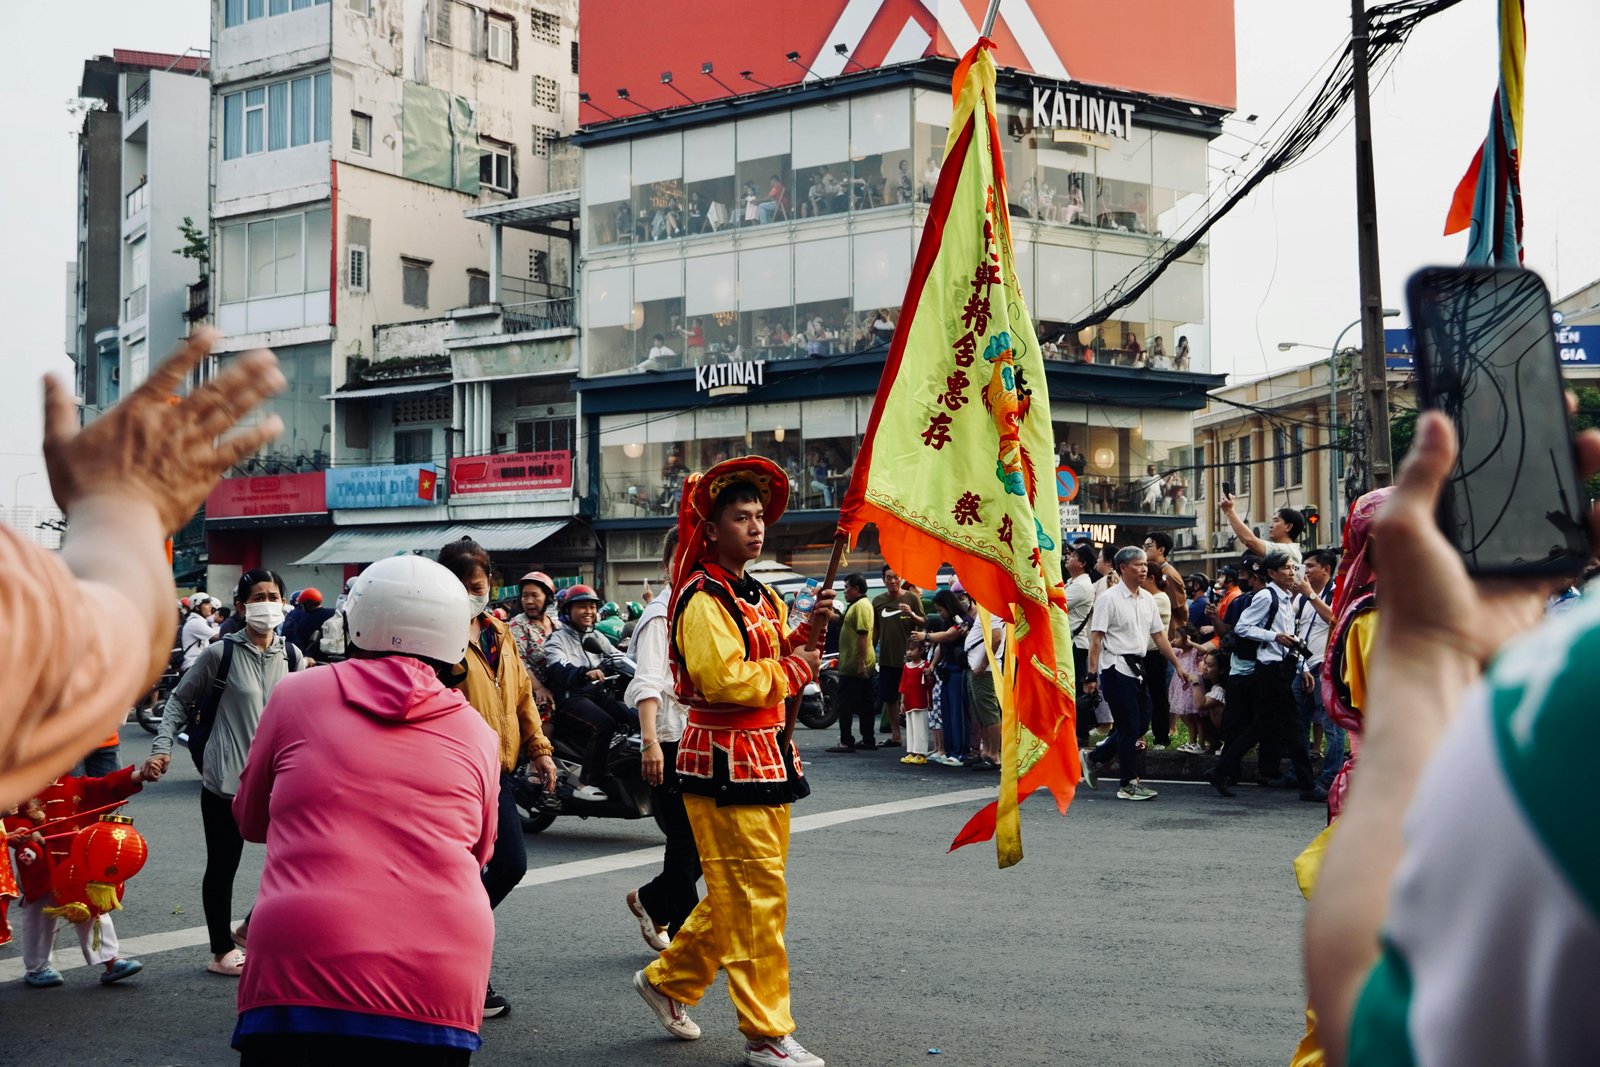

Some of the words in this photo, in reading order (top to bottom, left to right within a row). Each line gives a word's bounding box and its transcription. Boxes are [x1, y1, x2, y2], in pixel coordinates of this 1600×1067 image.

[1033, 86, 1135, 142] KATINAT
[1560, 348, 1587, 361] GIA
[695, 359, 765, 392] KATINAT
[336, 481, 387, 496] THANH
[390, 476, 419, 497] DIỆ
